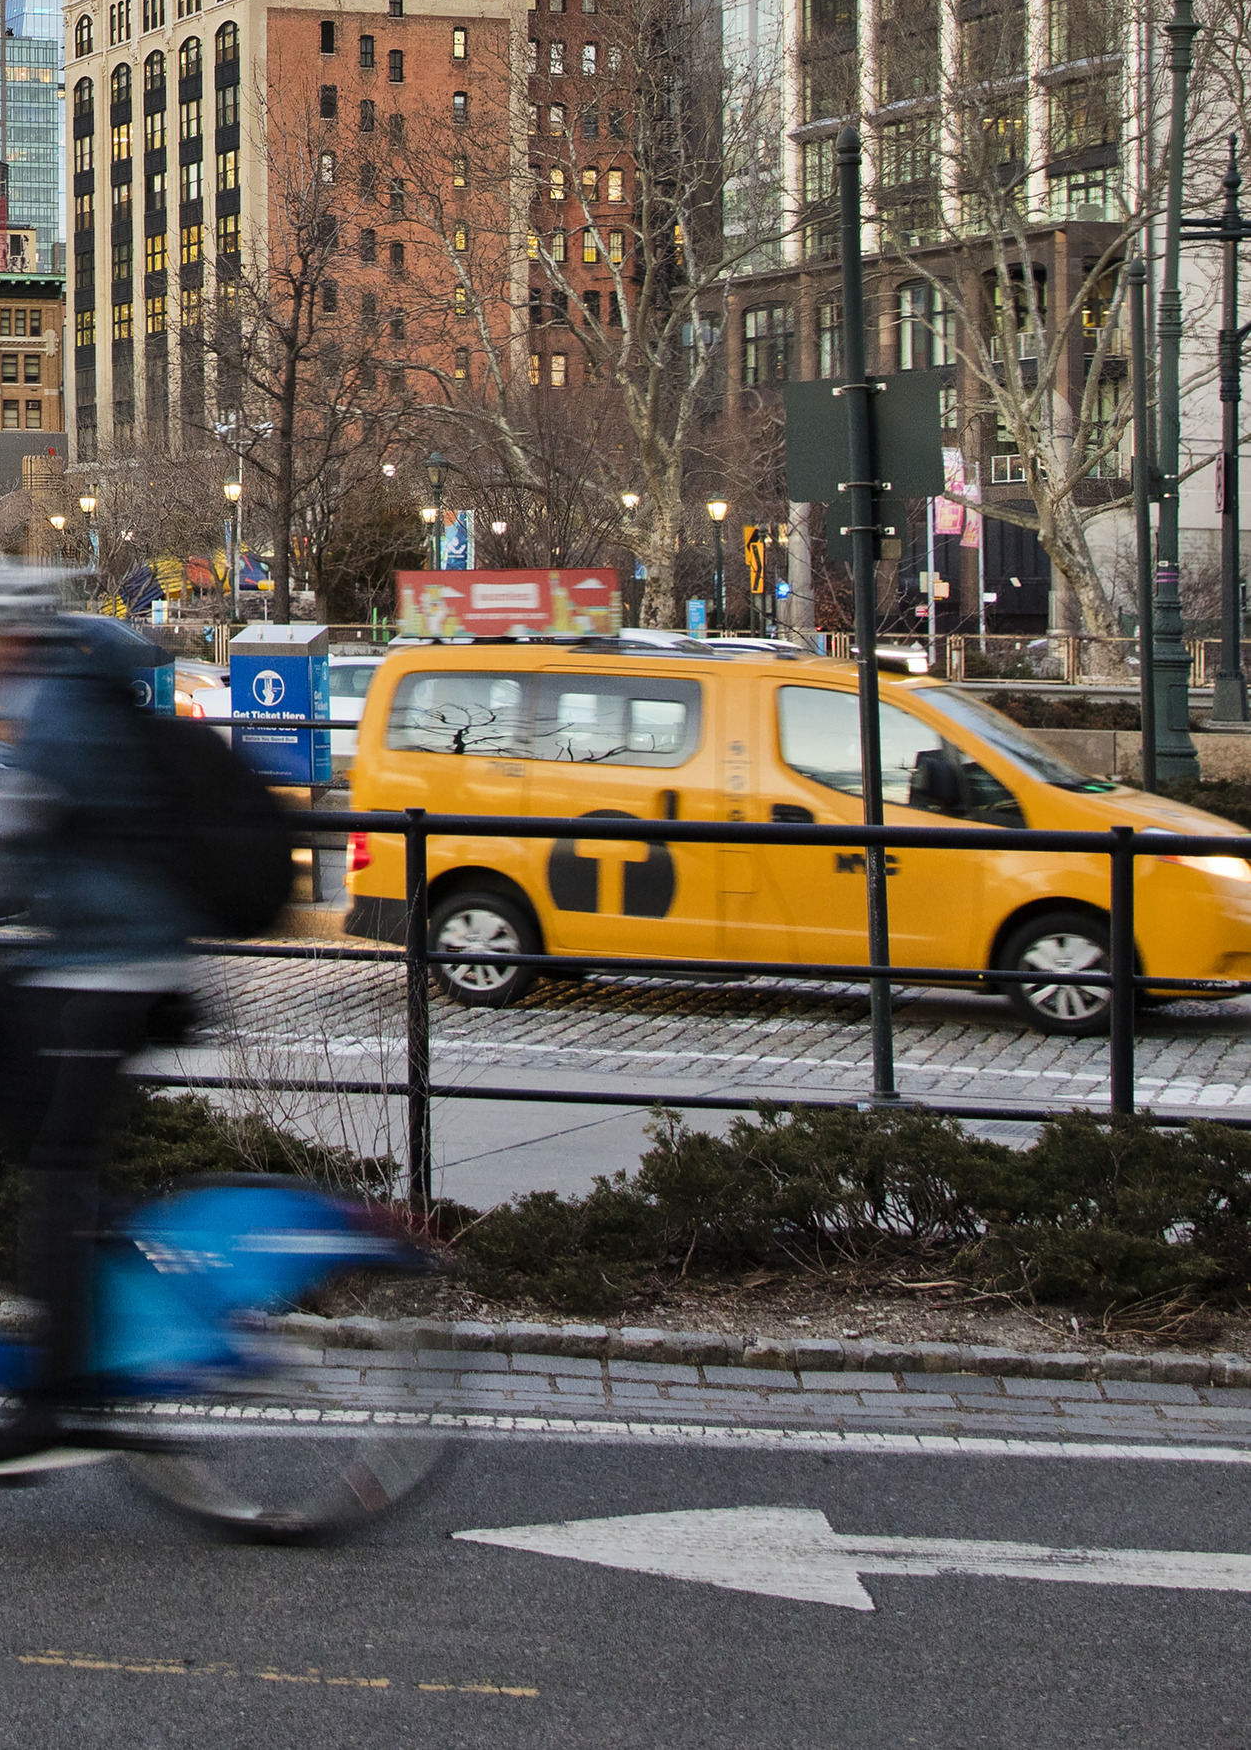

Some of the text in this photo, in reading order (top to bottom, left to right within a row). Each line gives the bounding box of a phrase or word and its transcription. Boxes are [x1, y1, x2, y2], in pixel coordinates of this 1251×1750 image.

[233, 710, 306, 720] Get Ticket Here
